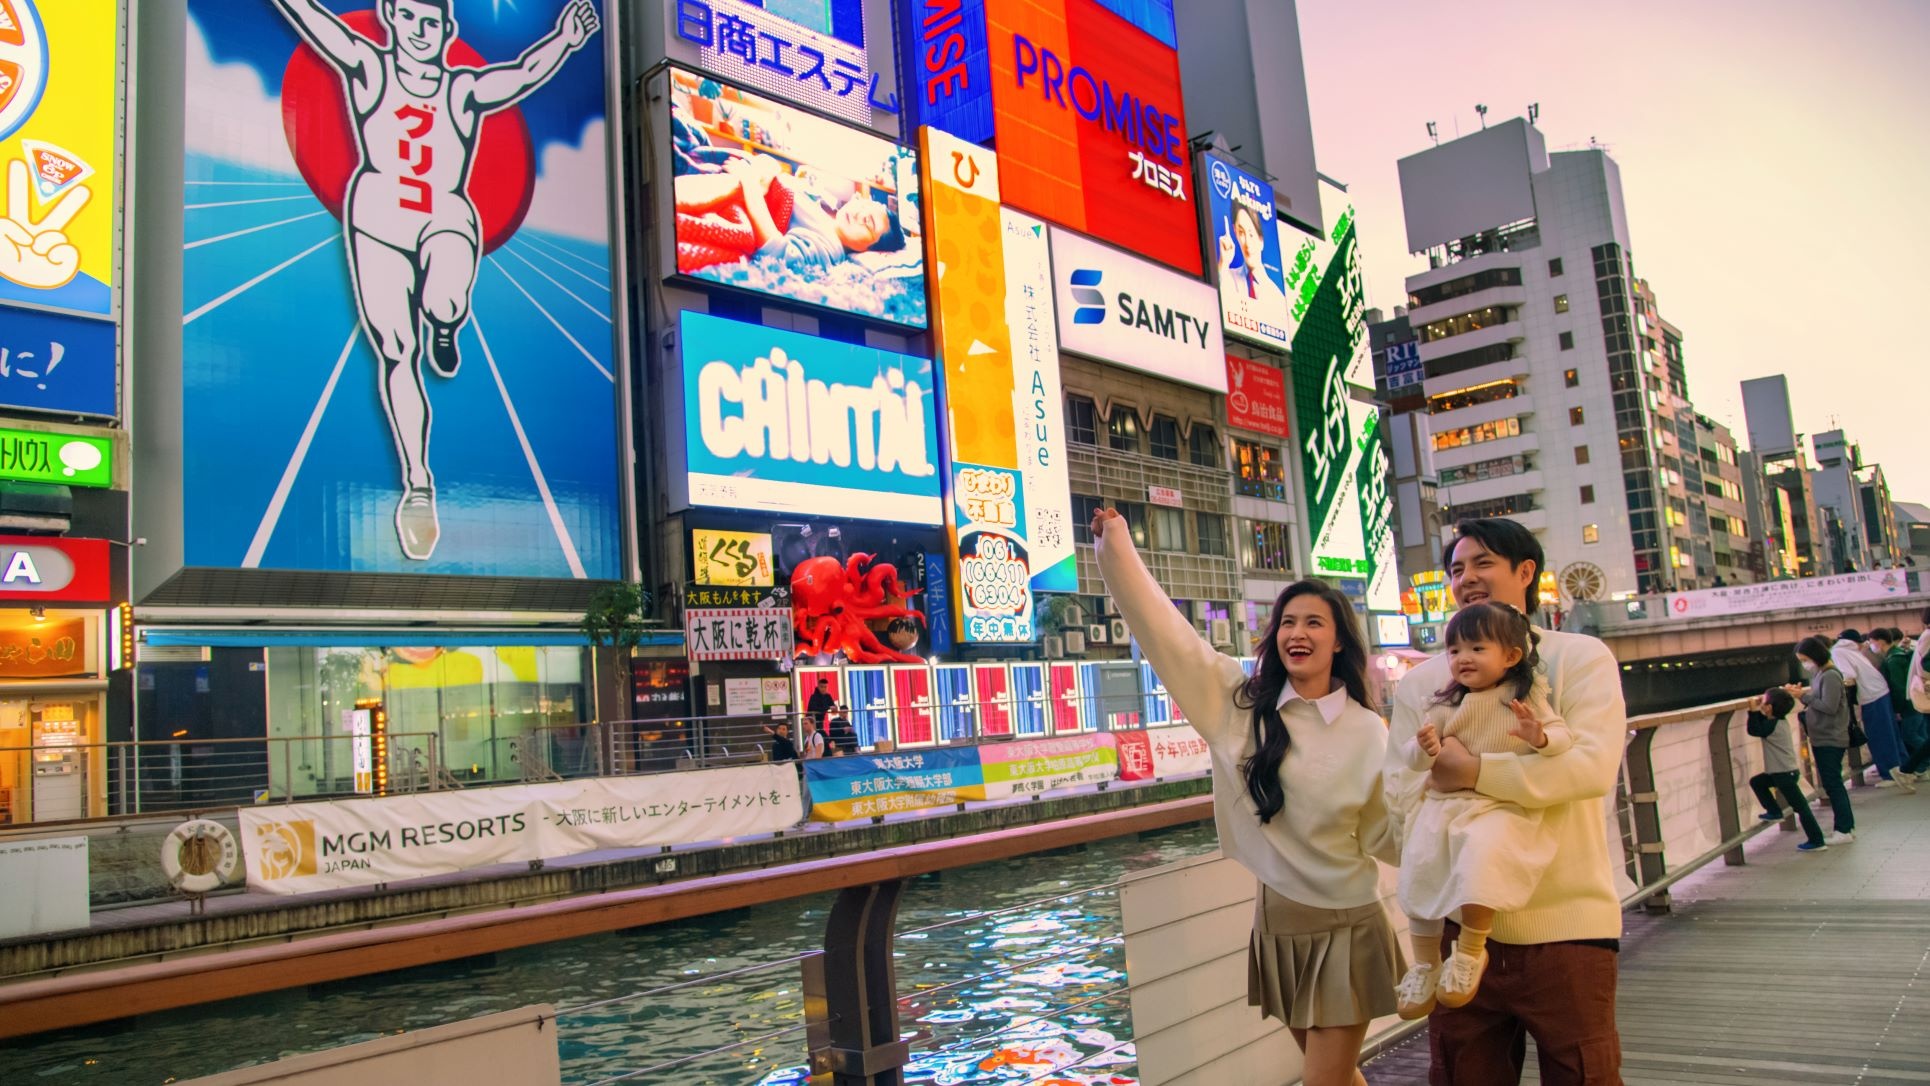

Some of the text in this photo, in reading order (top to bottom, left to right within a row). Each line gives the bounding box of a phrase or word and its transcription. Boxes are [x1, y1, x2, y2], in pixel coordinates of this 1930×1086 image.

[1013, 33, 1183, 166] PROMISE
[394, 104, 437, 213] グリコ
[951, 151, 980, 188] ひ
[1128, 151, 1187, 201] プロミス
[1118, 292, 1208, 349] SAMTY
[1031, 370, 1049, 466] Asue
[709, 538, 758, 577] くくる
[982, 540, 1006, 560] 06
[687, 589, 762, 605] 大阪もんを食す
[974, 584, 1021, 606] 6304
[693, 618, 778, 651] 大阪に乾杯
[322, 812, 526, 857] MGM RESORTS
[324, 858, 371, 874] JAPAN
